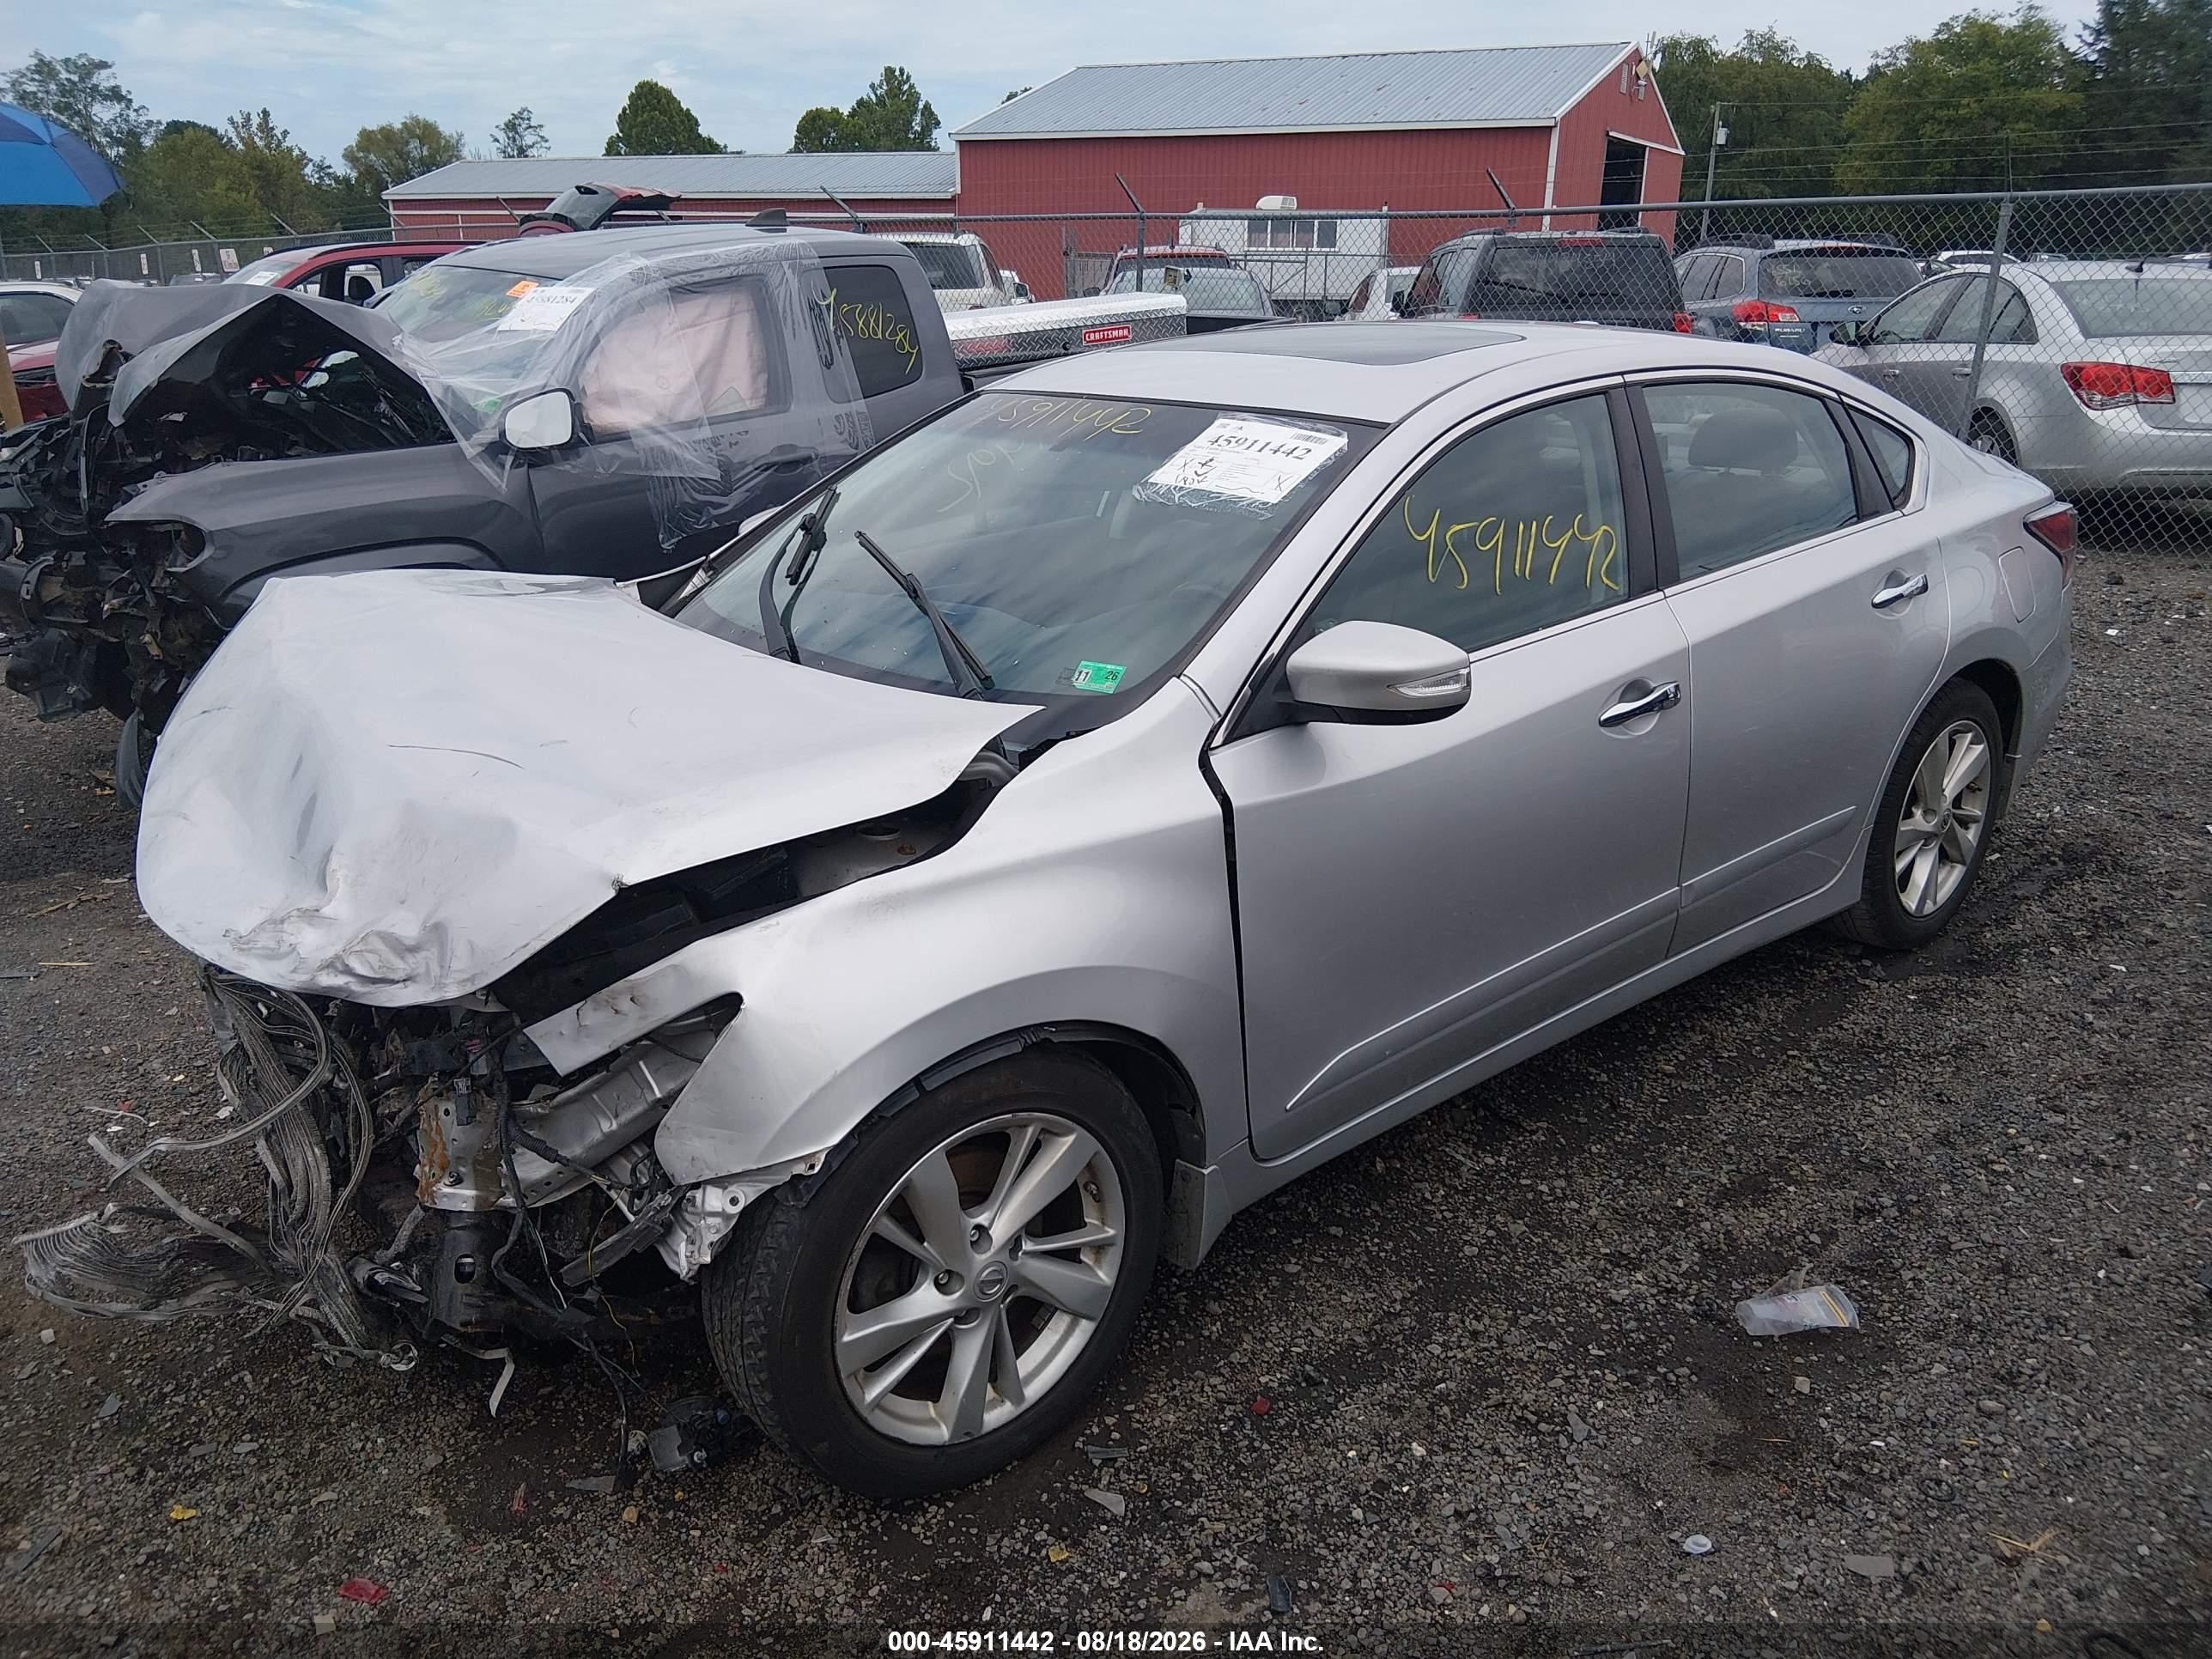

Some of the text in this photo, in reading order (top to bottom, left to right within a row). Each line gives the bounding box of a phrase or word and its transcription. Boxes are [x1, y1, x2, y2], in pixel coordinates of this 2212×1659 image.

[811, 281, 919, 375] 45881284
[1085, 329, 1128, 341] CRAFTSMAN
[967, 398, 1152, 441] 45911442
[1208, 434, 1312, 460] 45911442
[1403, 495, 1620, 596] 45911442
[1075, 670, 1120, 683] 11 26
